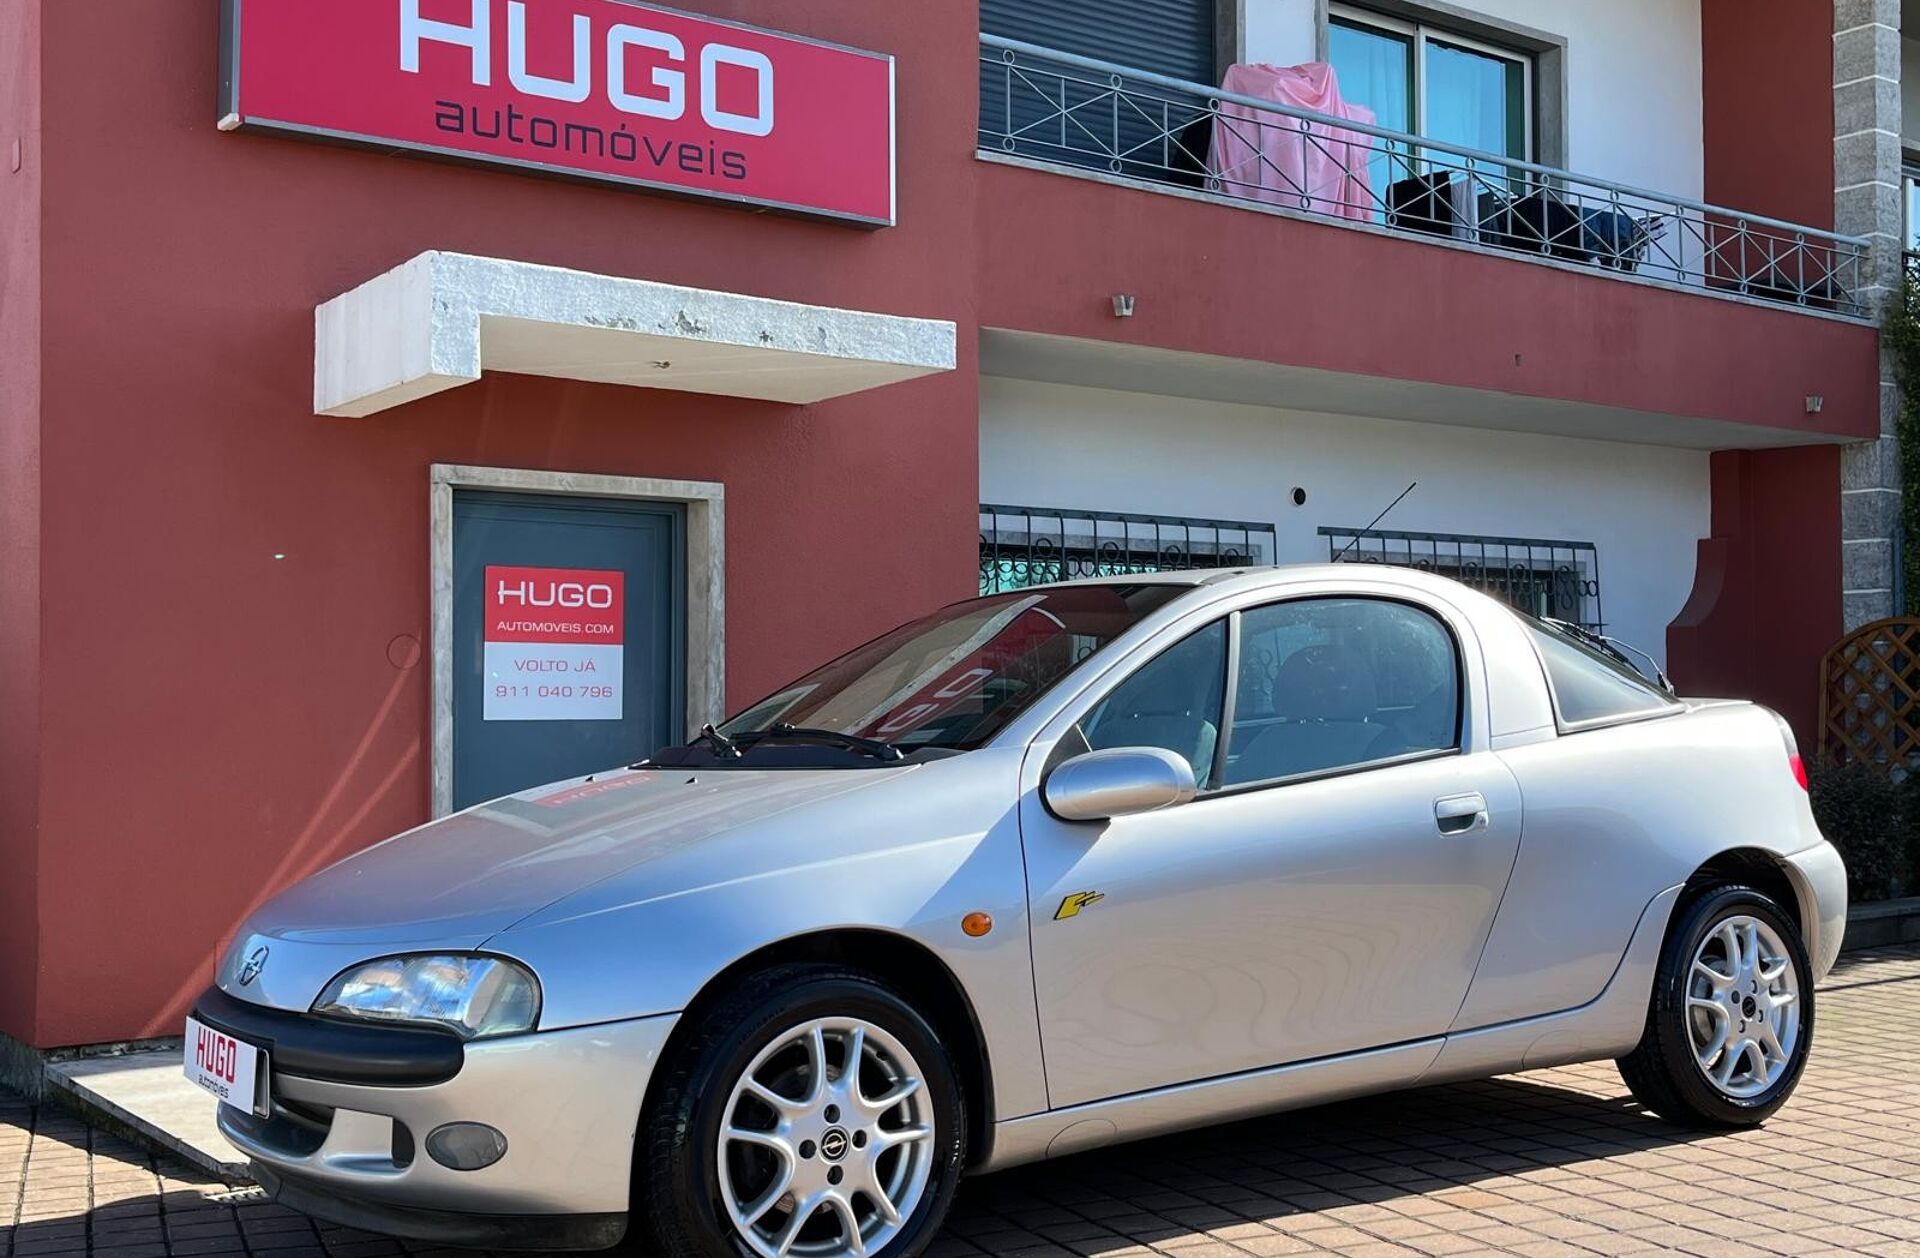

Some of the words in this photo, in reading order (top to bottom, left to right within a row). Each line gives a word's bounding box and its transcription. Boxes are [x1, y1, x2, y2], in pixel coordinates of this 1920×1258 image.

[400, 0, 774, 137] HUGO
[435, 101, 746, 179] automóveis
[497, 580, 613, 608] HUGO
[514, 659, 568, 672] VOLTO
[496, 685, 530, 698] 911
[538, 685, 572, 698] 040
[580, 686, 613, 698] 796
[196, 1026, 237, 1084] HUGO
